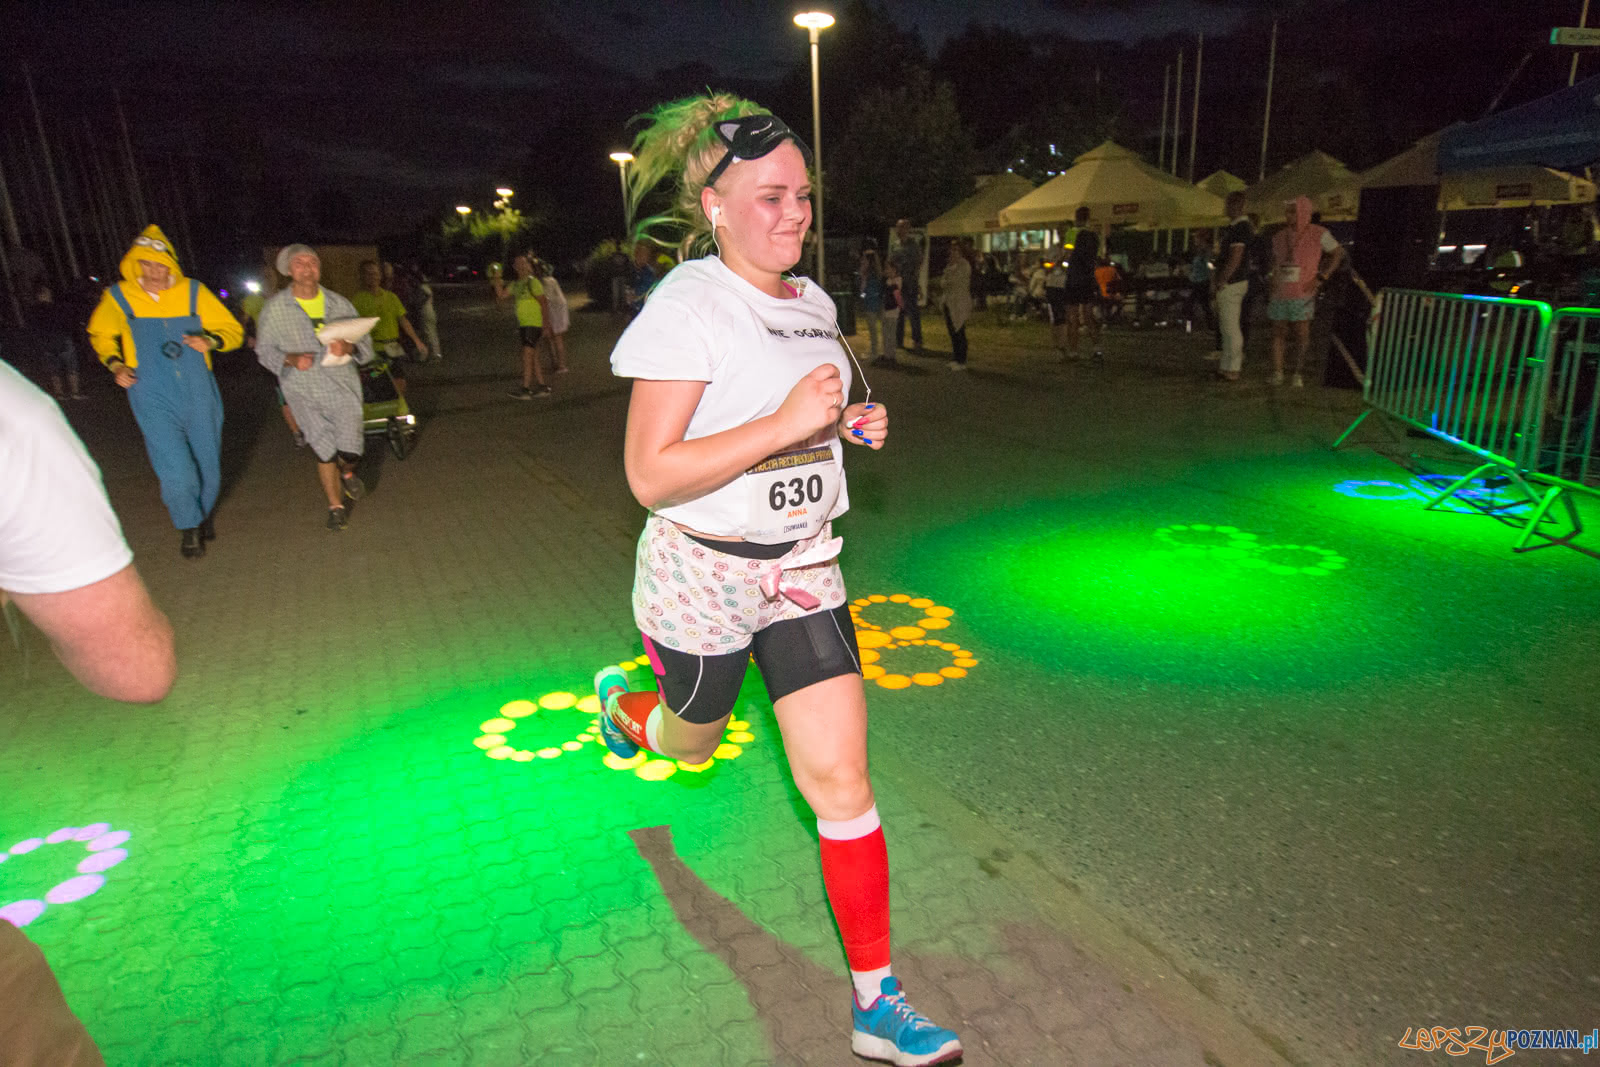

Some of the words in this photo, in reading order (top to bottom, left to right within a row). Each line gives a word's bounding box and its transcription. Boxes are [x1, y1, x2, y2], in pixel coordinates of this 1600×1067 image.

[767, 327, 790, 338] NIE
[768, 474, 823, 511] 630
[787, 508, 808, 518] ANNA
